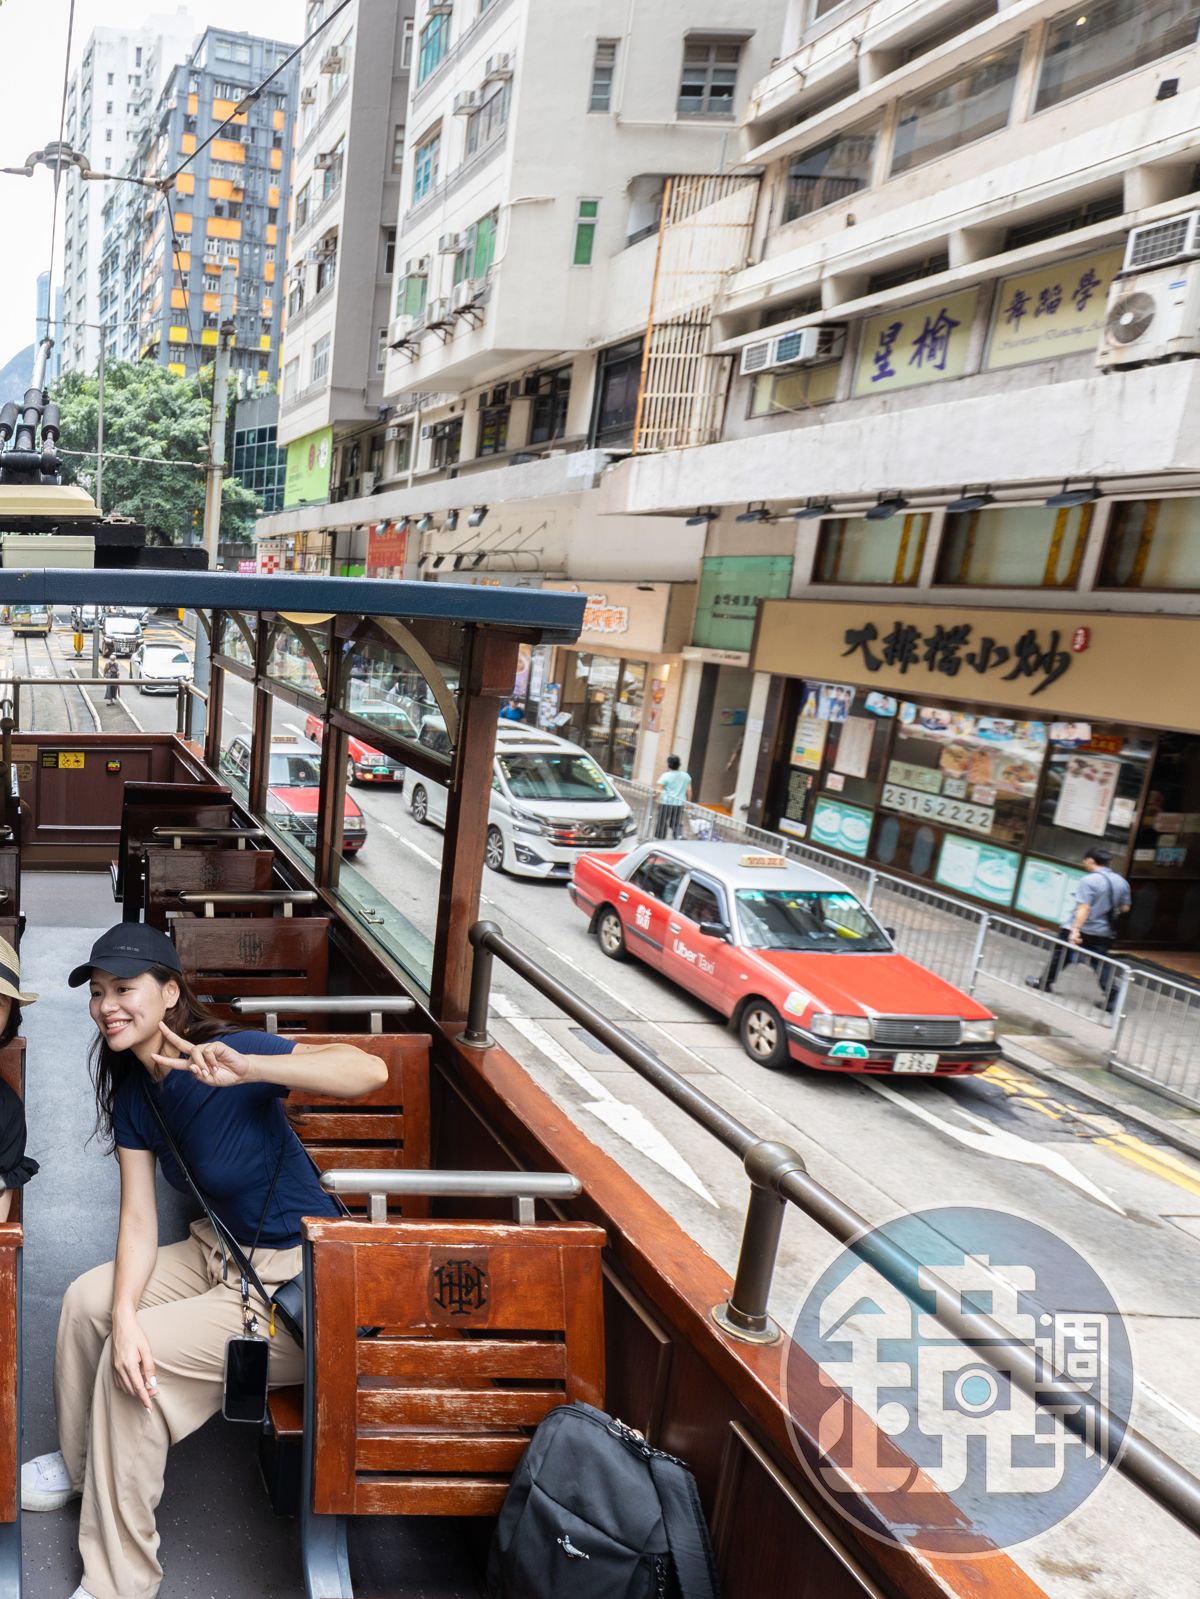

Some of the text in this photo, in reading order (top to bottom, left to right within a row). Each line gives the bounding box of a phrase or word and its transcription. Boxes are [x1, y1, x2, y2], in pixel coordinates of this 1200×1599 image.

[841, 621, 1071, 696] 大排檔小炒
[885, 788, 990, 828] 25152222
